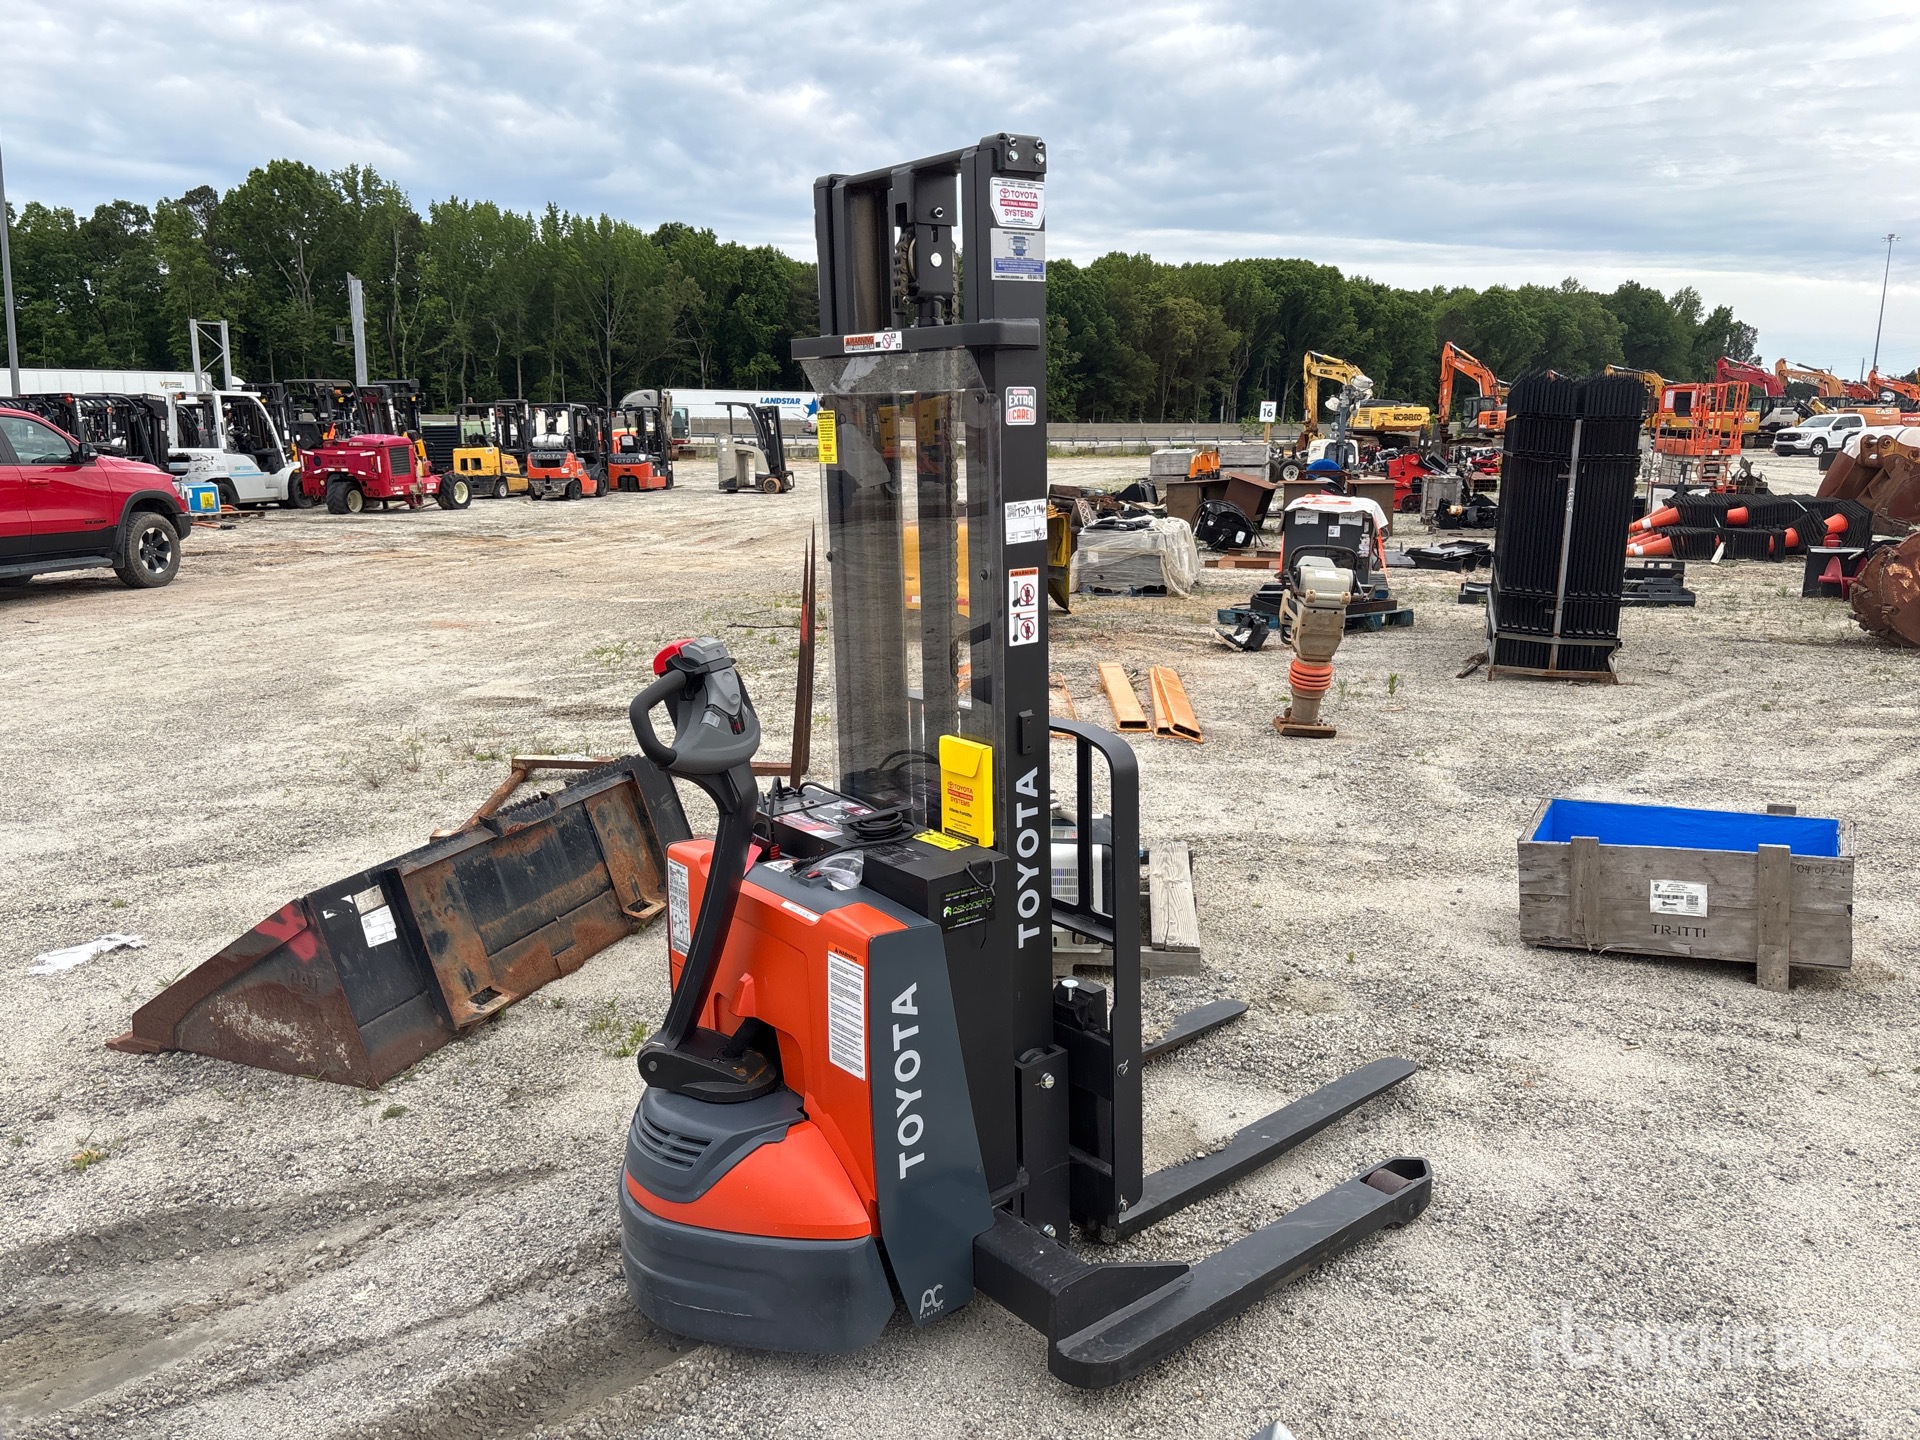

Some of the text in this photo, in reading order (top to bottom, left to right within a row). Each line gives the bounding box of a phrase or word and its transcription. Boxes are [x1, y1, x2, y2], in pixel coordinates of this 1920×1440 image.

[1011, 190, 1038, 199] TOYOTA
[1004, 209, 1034, 218] SYSTEMS
[1800, 374, 1820, 385] CASE
[1008, 395, 1034, 407] EXTRA
[1012, 409, 1030, 420] CARE
[1263, 408, 1273, 417] 16
[1393, 413, 1422, 421] KOBELCO
[954, 783, 973, 794] TOYOTA
[950, 796, 971, 807] SYSTEMS
[1016, 767, 1040, 949] TOYOTA
[839, 949, 858, 962] WARNING
[892, 982, 925, 1180] TOYOTA
